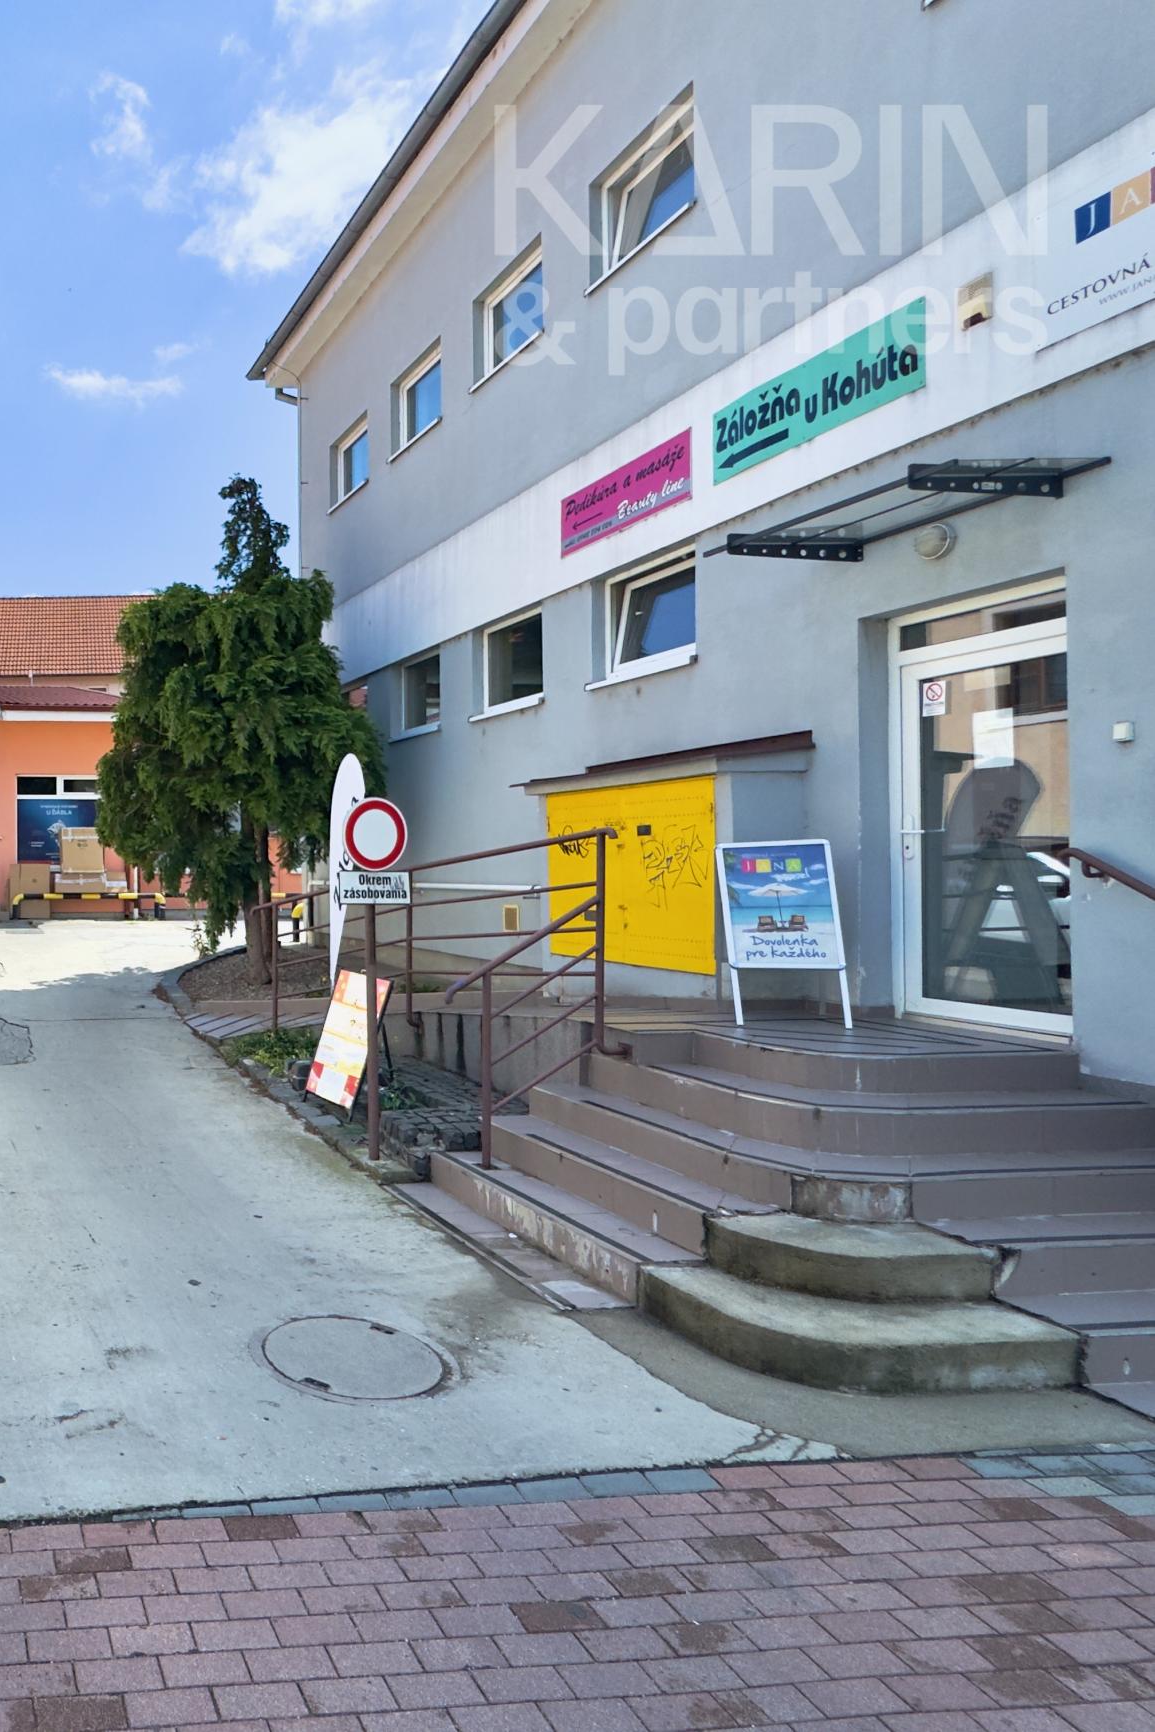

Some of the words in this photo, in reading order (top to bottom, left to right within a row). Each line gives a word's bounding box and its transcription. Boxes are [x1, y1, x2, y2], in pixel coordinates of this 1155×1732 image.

[1047, 252, 1151, 315] CESTOVNÁ
[716, 383, 801, 453] Záložňa
[804, 393, 818, 423] u
[822, 344, 919, 416] Kohúta
[623, 475, 631, 489] a
[635, 444, 685, 481] masáže
[617, 490, 658, 519] Beauty
[661, 477, 685, 497] line
[343, 887, 408, 900] zásobovania
[358, 873, 392, 887] Okrem
[746, 949, 768, 961] pre
[771, 946, 827, 959] každého
[750, 934, 819, 946] Dovolenka
